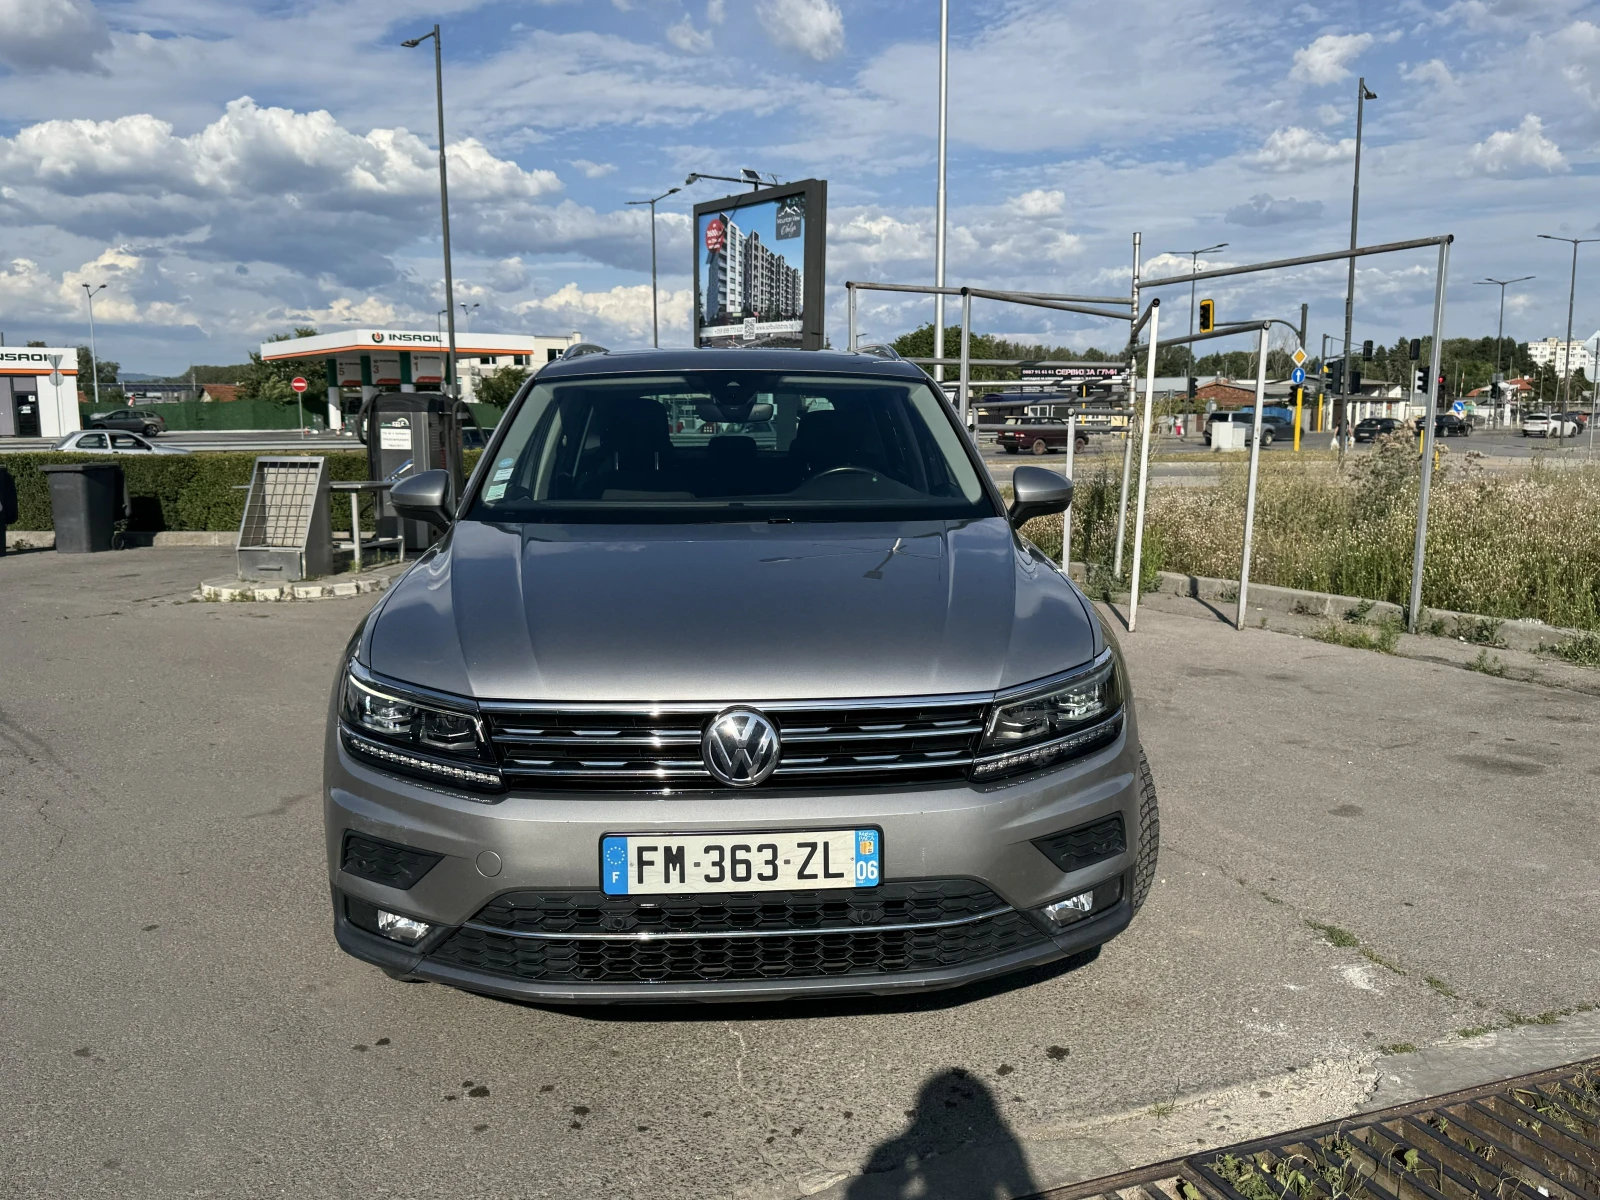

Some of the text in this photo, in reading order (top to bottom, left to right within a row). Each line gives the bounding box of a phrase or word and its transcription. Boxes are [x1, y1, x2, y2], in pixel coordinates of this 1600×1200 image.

[389, 333, 443, 342] INSAOIL
[0, 353, 48, 361] SAOI
[636, 841, 845, 885] FM-363-ZL
[856, 860, 878, 880] 06
[612, 871, 620, 883] F
